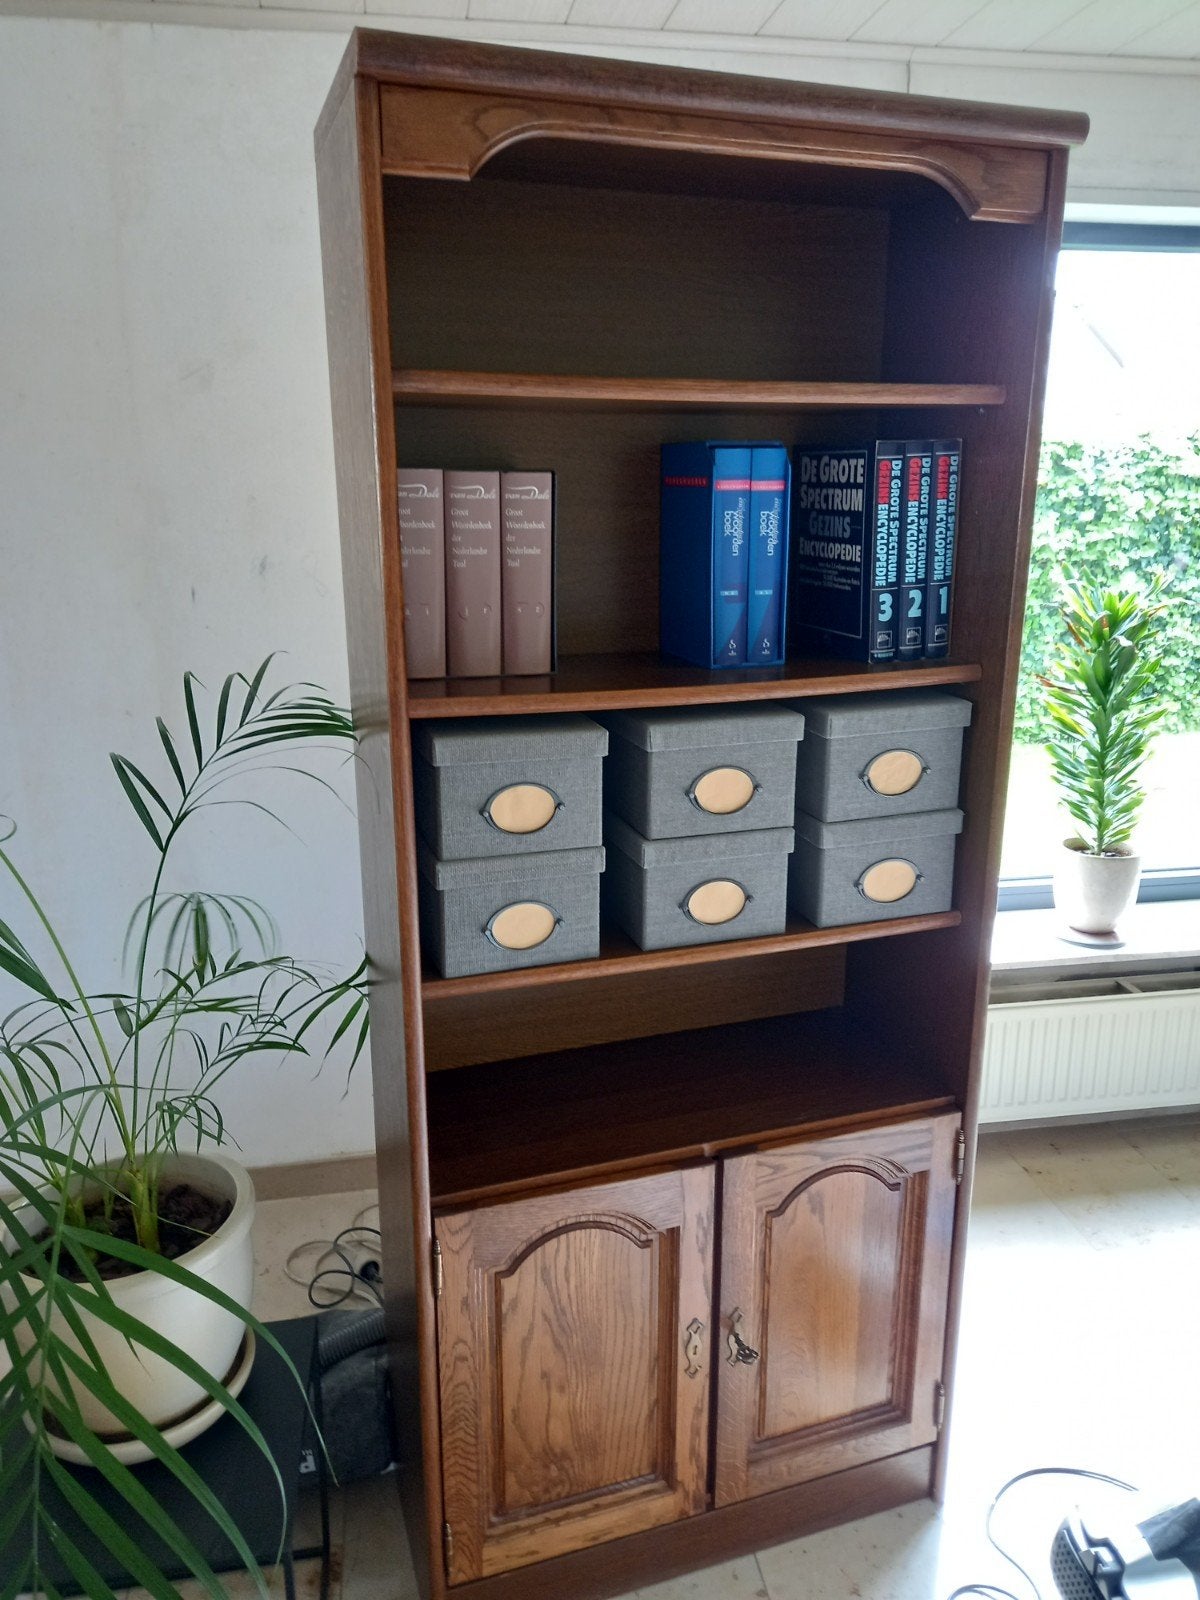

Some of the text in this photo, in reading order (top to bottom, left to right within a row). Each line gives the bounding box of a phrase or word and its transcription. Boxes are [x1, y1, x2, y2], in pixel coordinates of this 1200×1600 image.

[505, 508, 523, 517] Groot
[724, 510, 735, 536] boek
[760, 510, 770, 536] boek
[888, 459, 903, 583] DE GROTE SPECTRUM
[917, 457, 932, 579] DE GROTE SPECTRUM
[945, 455, 959, 576] DE GROTE SPECTRUM
[732, 511, 741, 556] woorden
[767, 511, 776, 556] woorden
[878, 592, 893, 622] 3
[907, 589, 923, 618] 2
[939, 586, 948, 615] 1
